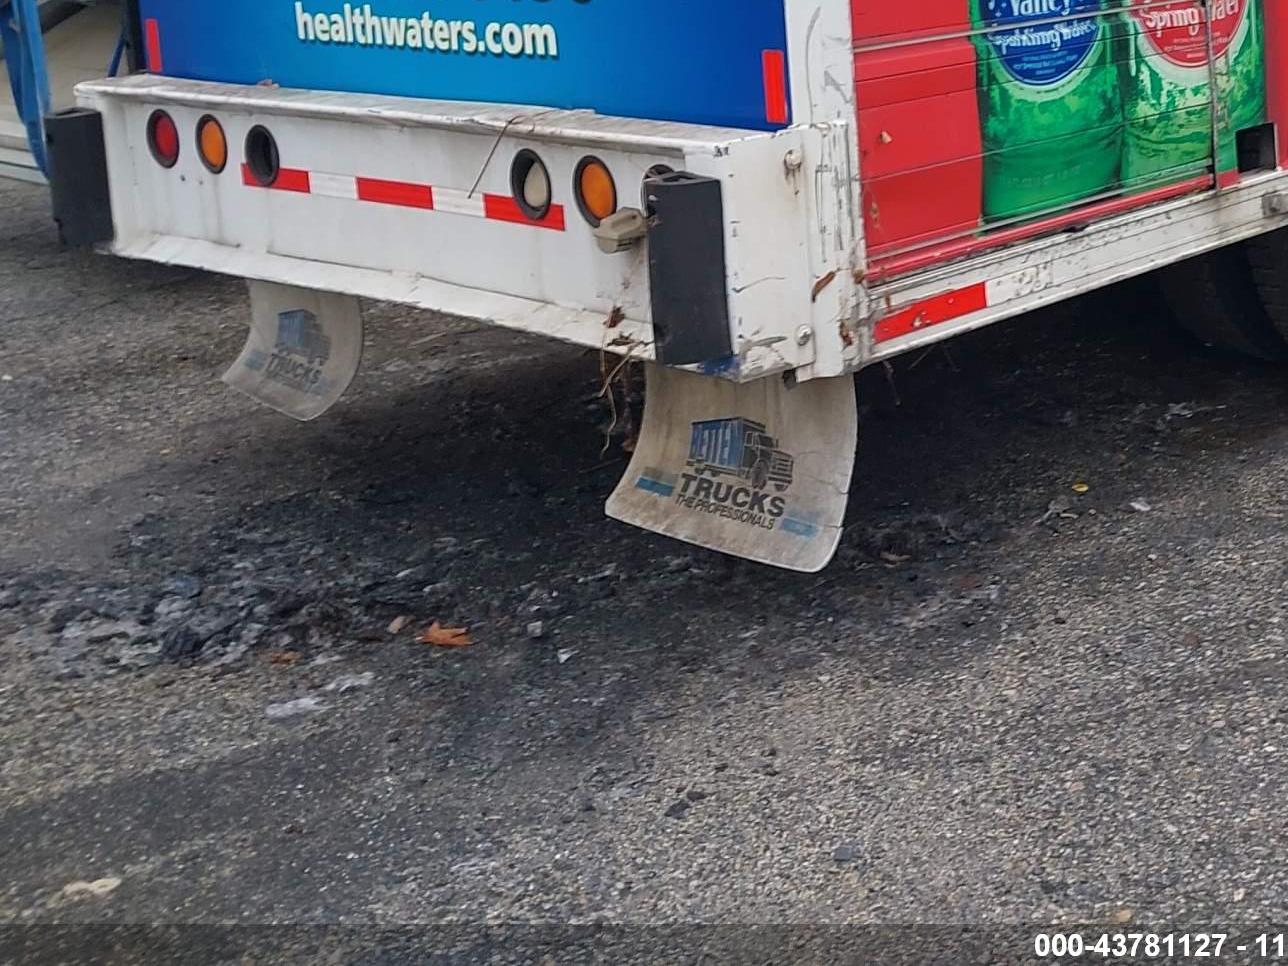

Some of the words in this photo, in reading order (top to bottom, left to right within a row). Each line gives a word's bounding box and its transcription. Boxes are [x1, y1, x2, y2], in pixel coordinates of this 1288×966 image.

[295, 1, 558, 57] healthwaters.com
[1139, 0, 1200, 37] Spring
[675, 494, 695, 509] THE
[693, 497, 776, 531] PROFESSIONALS
[680, 472, 786, 518] TRUCKS
